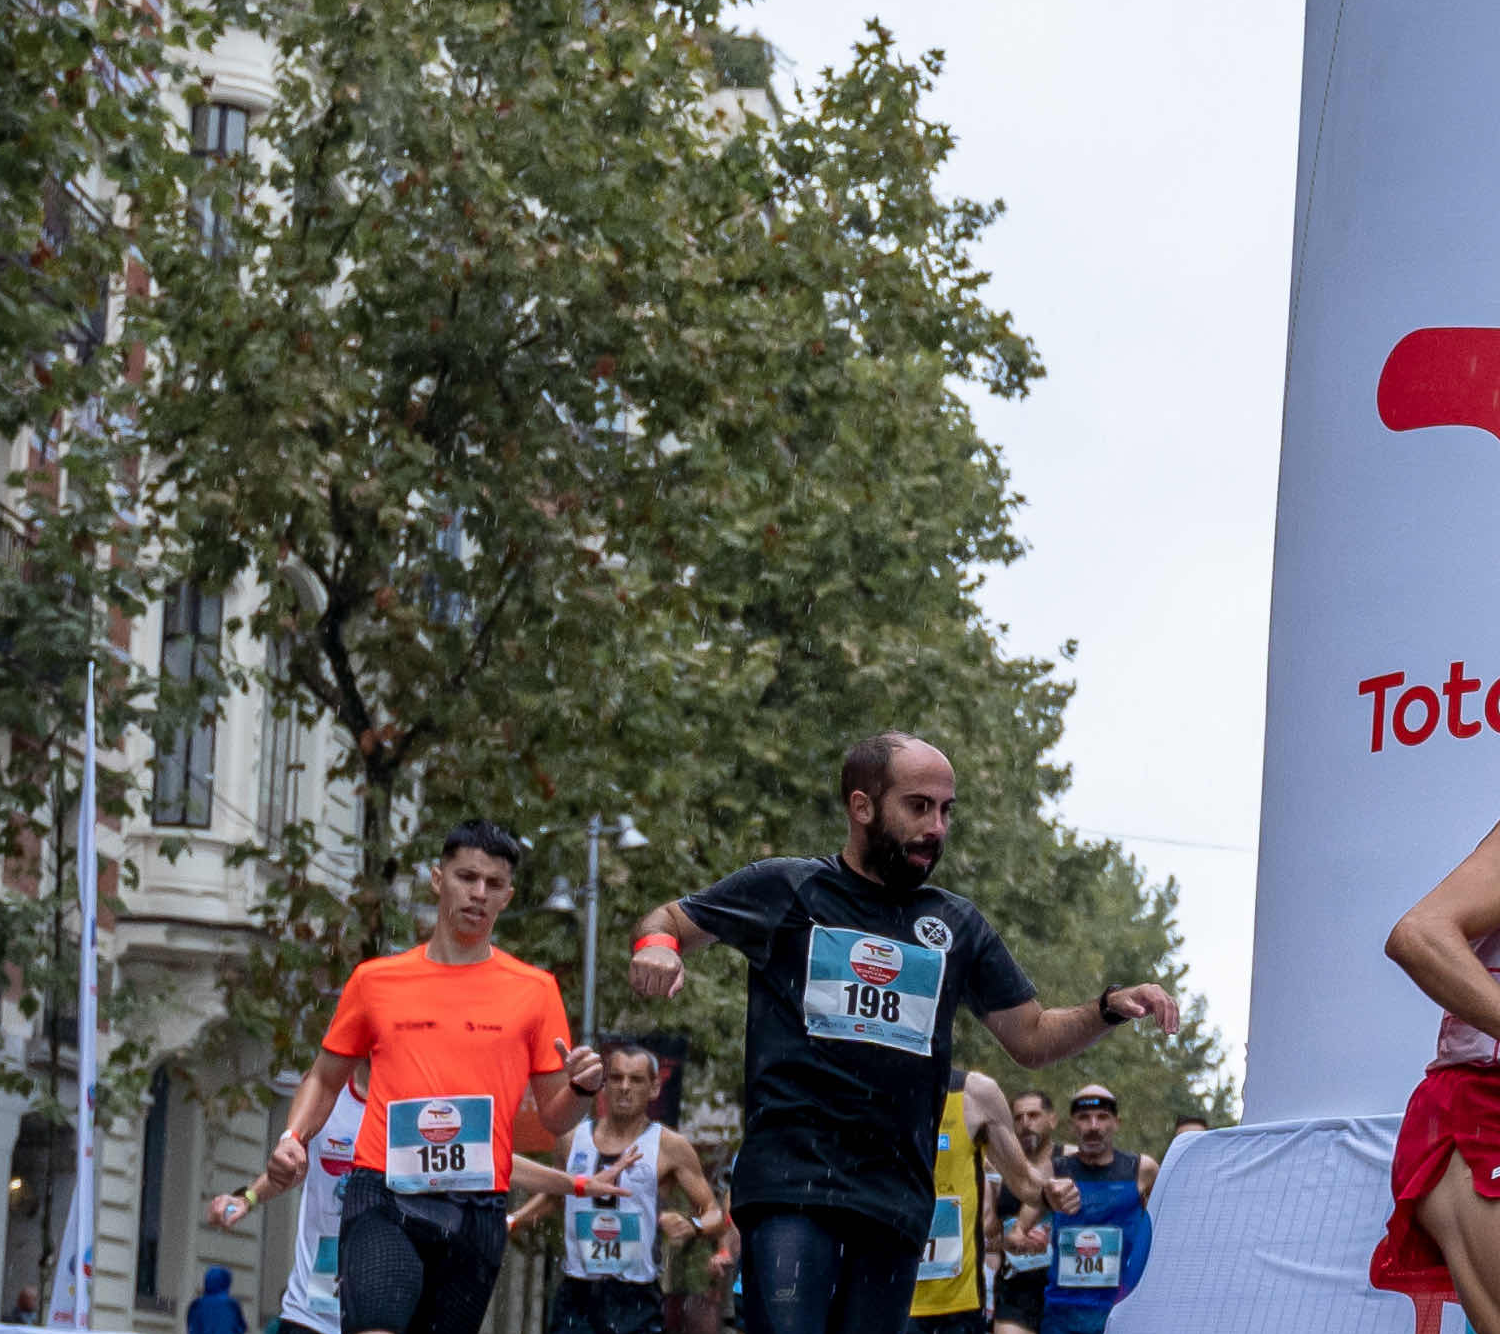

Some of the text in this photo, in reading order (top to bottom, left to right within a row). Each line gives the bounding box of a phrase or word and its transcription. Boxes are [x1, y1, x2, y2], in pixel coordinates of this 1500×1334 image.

[844, 983, 901, 1023] 198
[417, 1142, 466, 1173] 158
[591, 1241, 621, 1259] 214
[1075, 1257, 1104, 1275] 204
